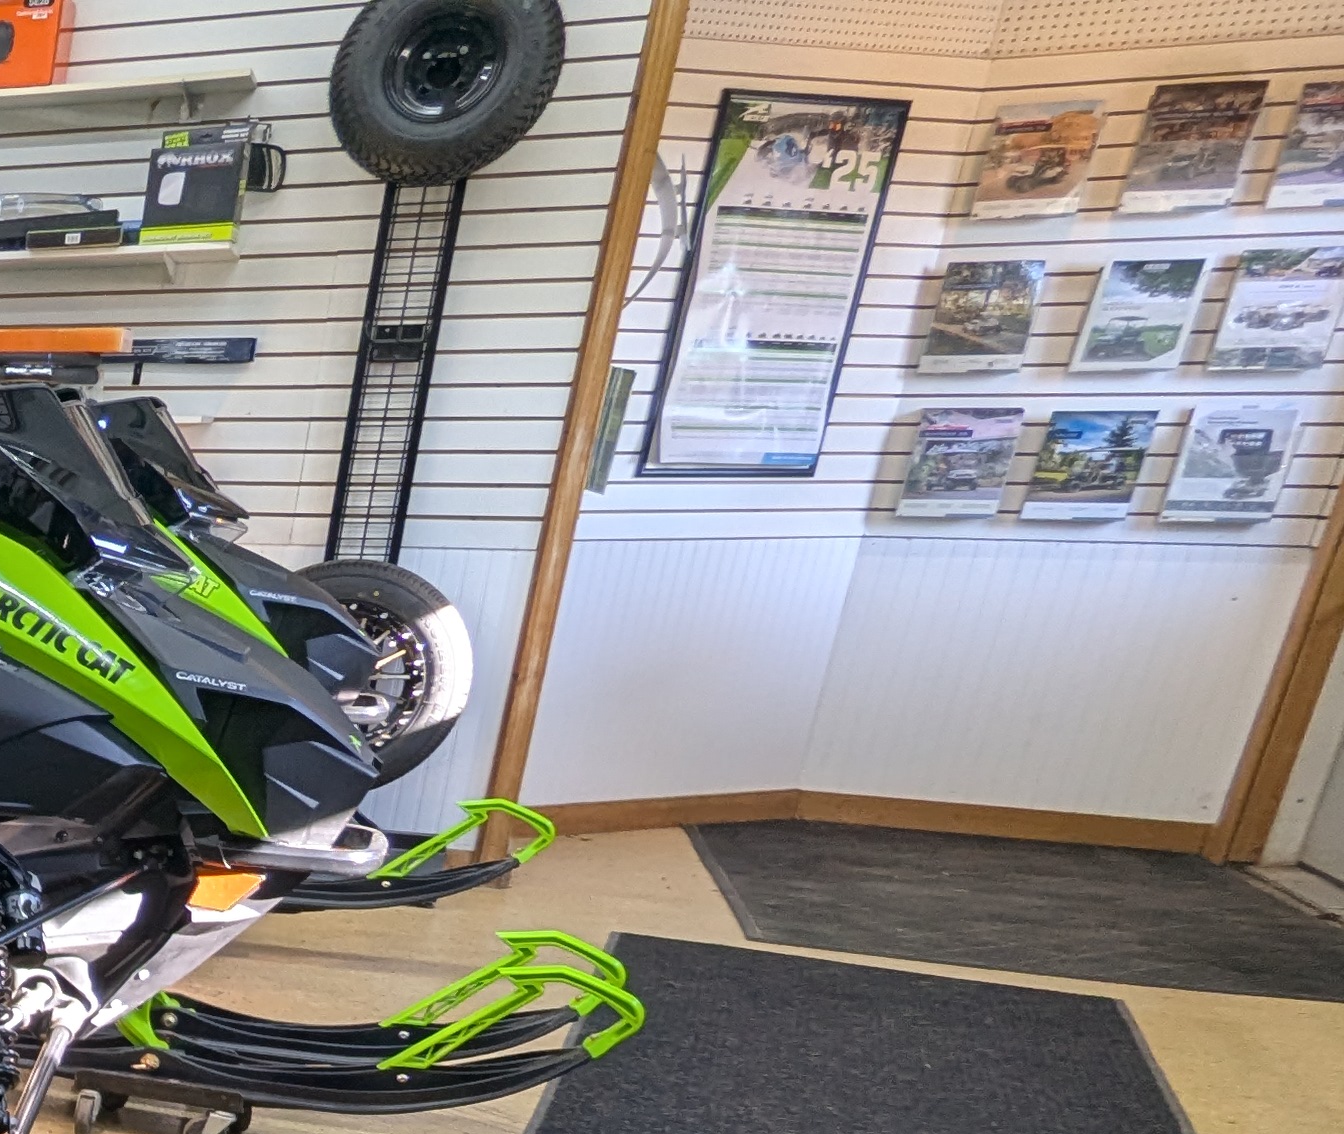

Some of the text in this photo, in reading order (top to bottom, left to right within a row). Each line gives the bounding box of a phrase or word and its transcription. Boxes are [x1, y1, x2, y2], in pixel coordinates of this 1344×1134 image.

[248, 588, 298, 602] CATALYST
[75, 640, 136, 685] CAT
[176, 670, 248, 692] CATALYST
